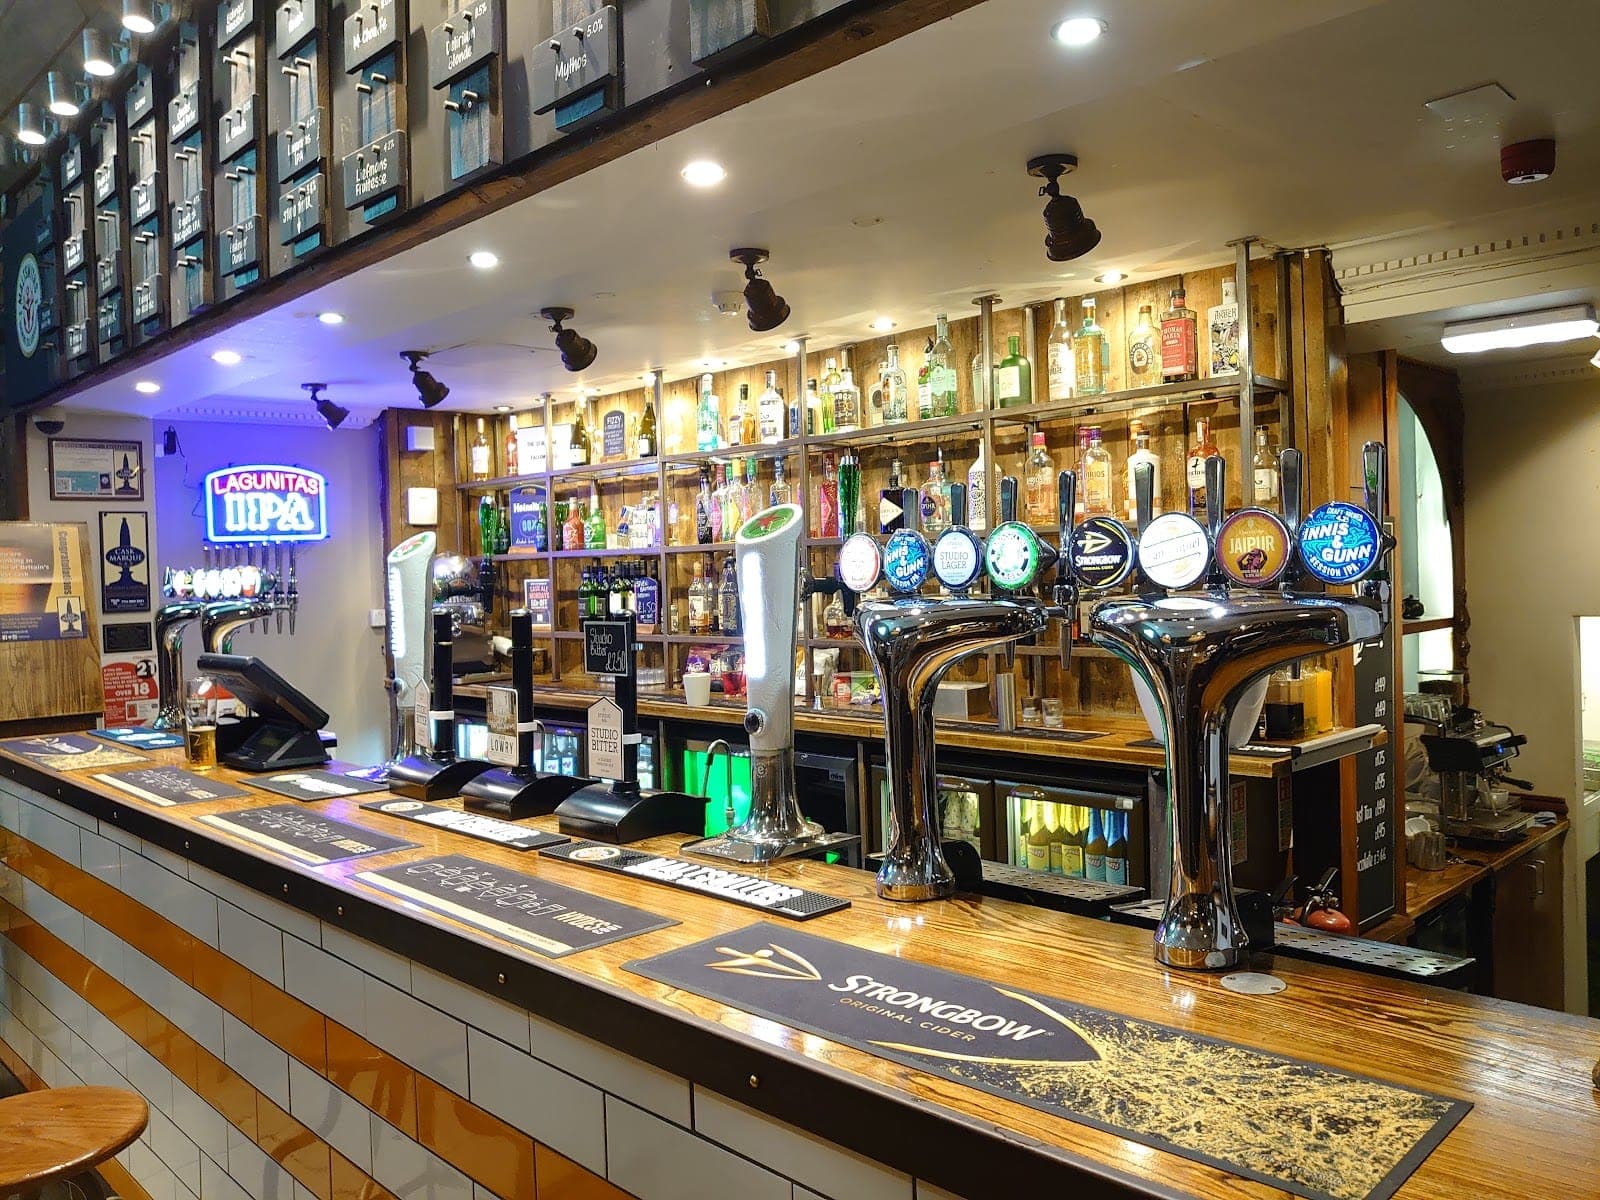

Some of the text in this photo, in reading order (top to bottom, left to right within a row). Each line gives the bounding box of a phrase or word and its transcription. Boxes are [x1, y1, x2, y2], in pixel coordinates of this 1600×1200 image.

[586, 19, 604, 38] 5.0%
[554, 54, 588, 81] Mythos
[213, 471, 320, 496] LAGUNITAS
[1303, 522, 1350, 541] INNIS
[1228, 534, 1276, 555] JAIPUR
[1331, 535, 1344, 549] &
[114, 547, 135, 556] CASK
[939, 551, 969, 561] STUDIO
[1075, 554, 1123, 567] STRONGBOW
[1321, 544, 1372, 563] GUNN
[895, 556, 924, 577] GUNN
[941, 560, 967, 570] LAGER
[1310, 555, 1360, 577] SESSION IPA
[589, 627, 613, 645] Studio
[590, 644, 609, 656] Bitter
[136, 660, 157, 677] 21
[115, 682, 151, 697] OVER 18
[591, 727, 619, 741] STUDIO
[490, 737, 514, 755] LOWRY
[591, 740, 619, 753] BITTER
[827, 973, 1047, 1042] STRONGBOW
[838, 996, 976, 1043] ORIGINAL CIDER
